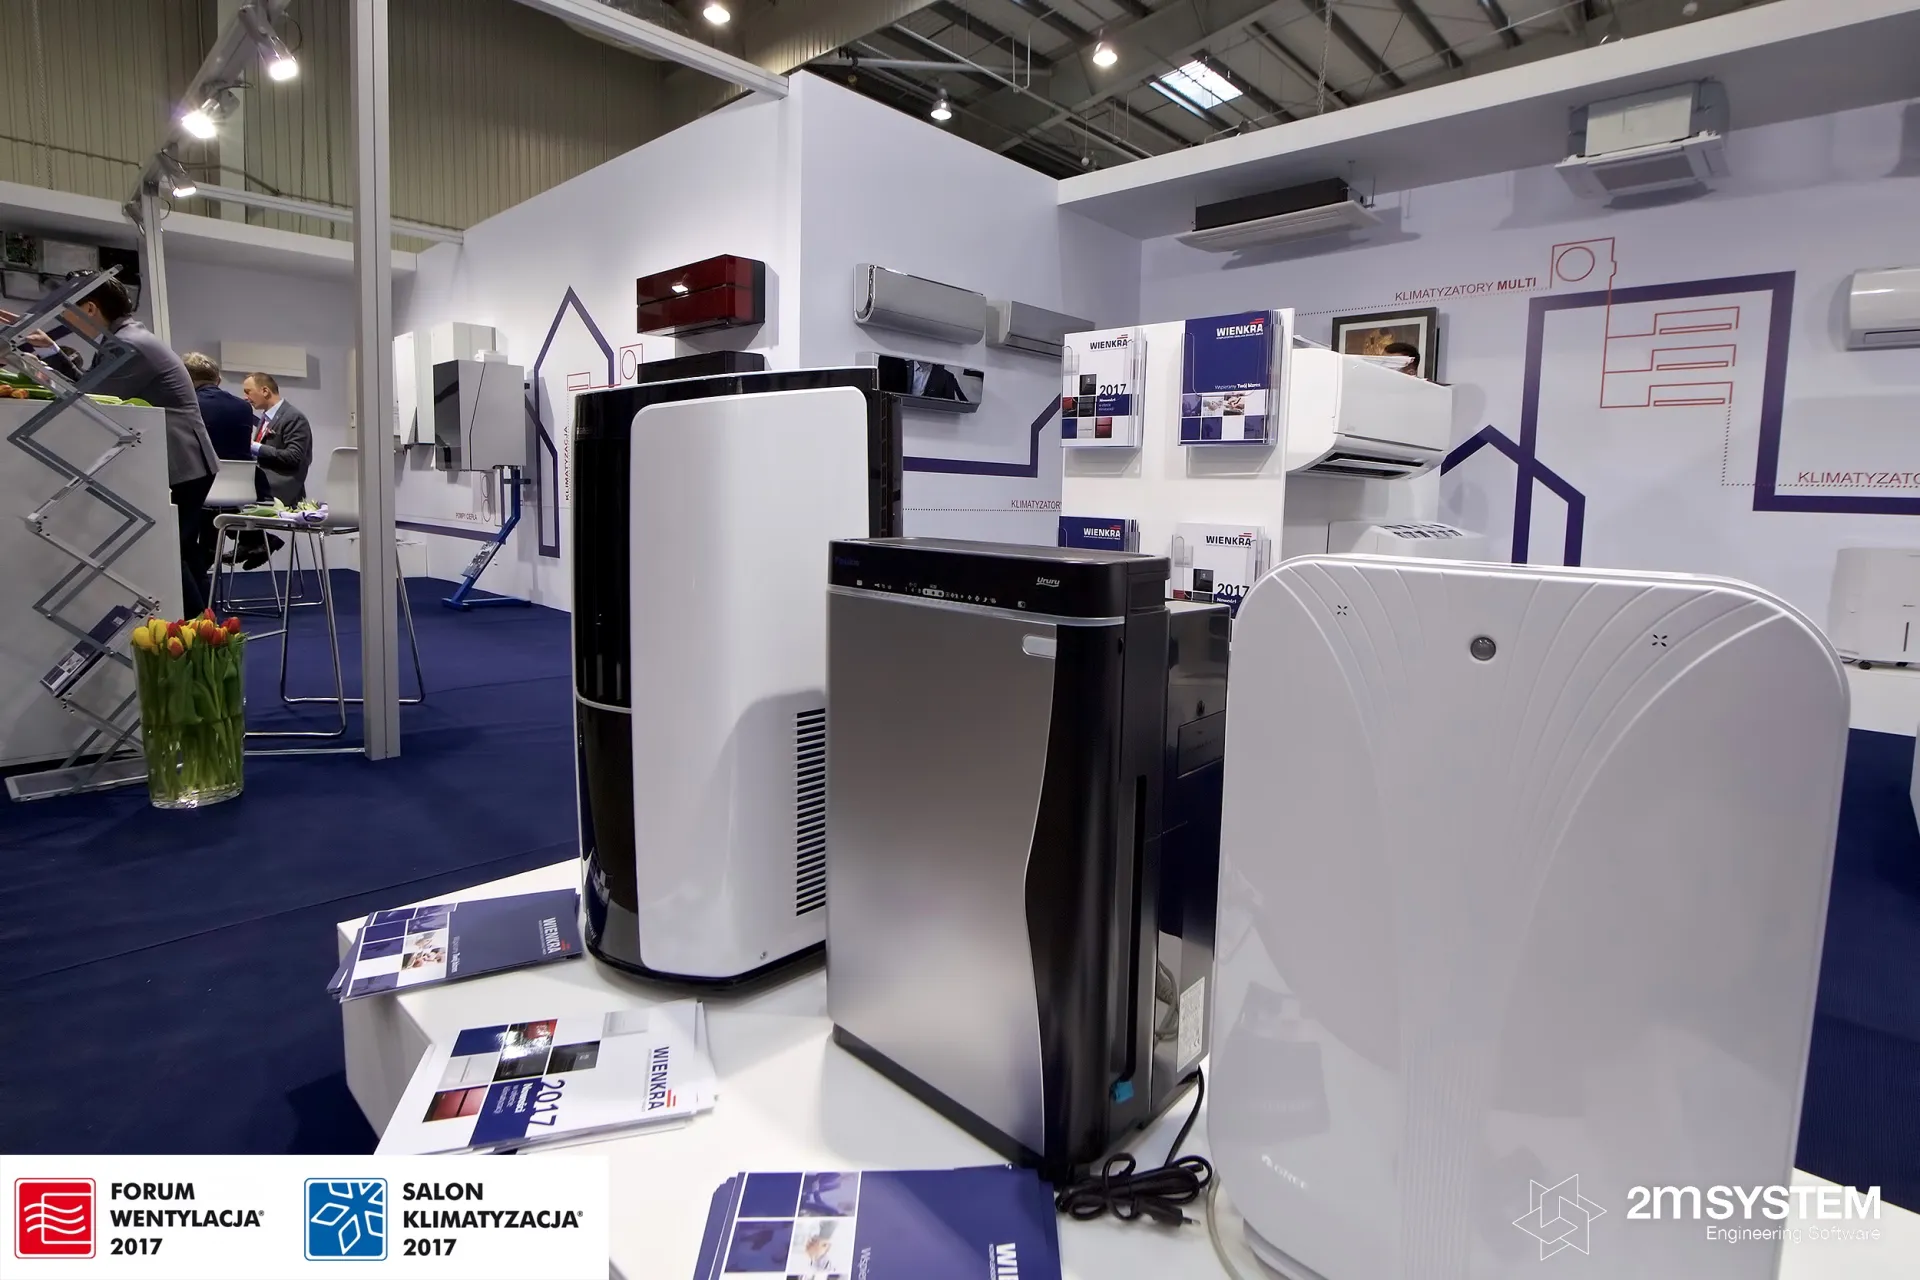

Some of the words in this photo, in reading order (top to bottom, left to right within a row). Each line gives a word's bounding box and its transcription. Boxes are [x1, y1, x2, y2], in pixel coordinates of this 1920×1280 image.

[1395, 282, 1494, 301] KLIMATYZATORY
[1497, 277, 1536, 291] MULTI
[1216, 323, 1264, 337] WIENKRA
[1090, 339, 1128, 350] WIENKRA
[1100, 383, 1127, 396] 2017
[1083, 527, 1121, 538] WIENKRA
[1205, 535, 1251, 547] WIENKRA
[1217, 583, 1250, 598] 2017
[543, 917, 561, 954] WIENKRA
[648, 1046, 670, 1111] WIENKRA
[529, 1079, 566, 1126] 2017
